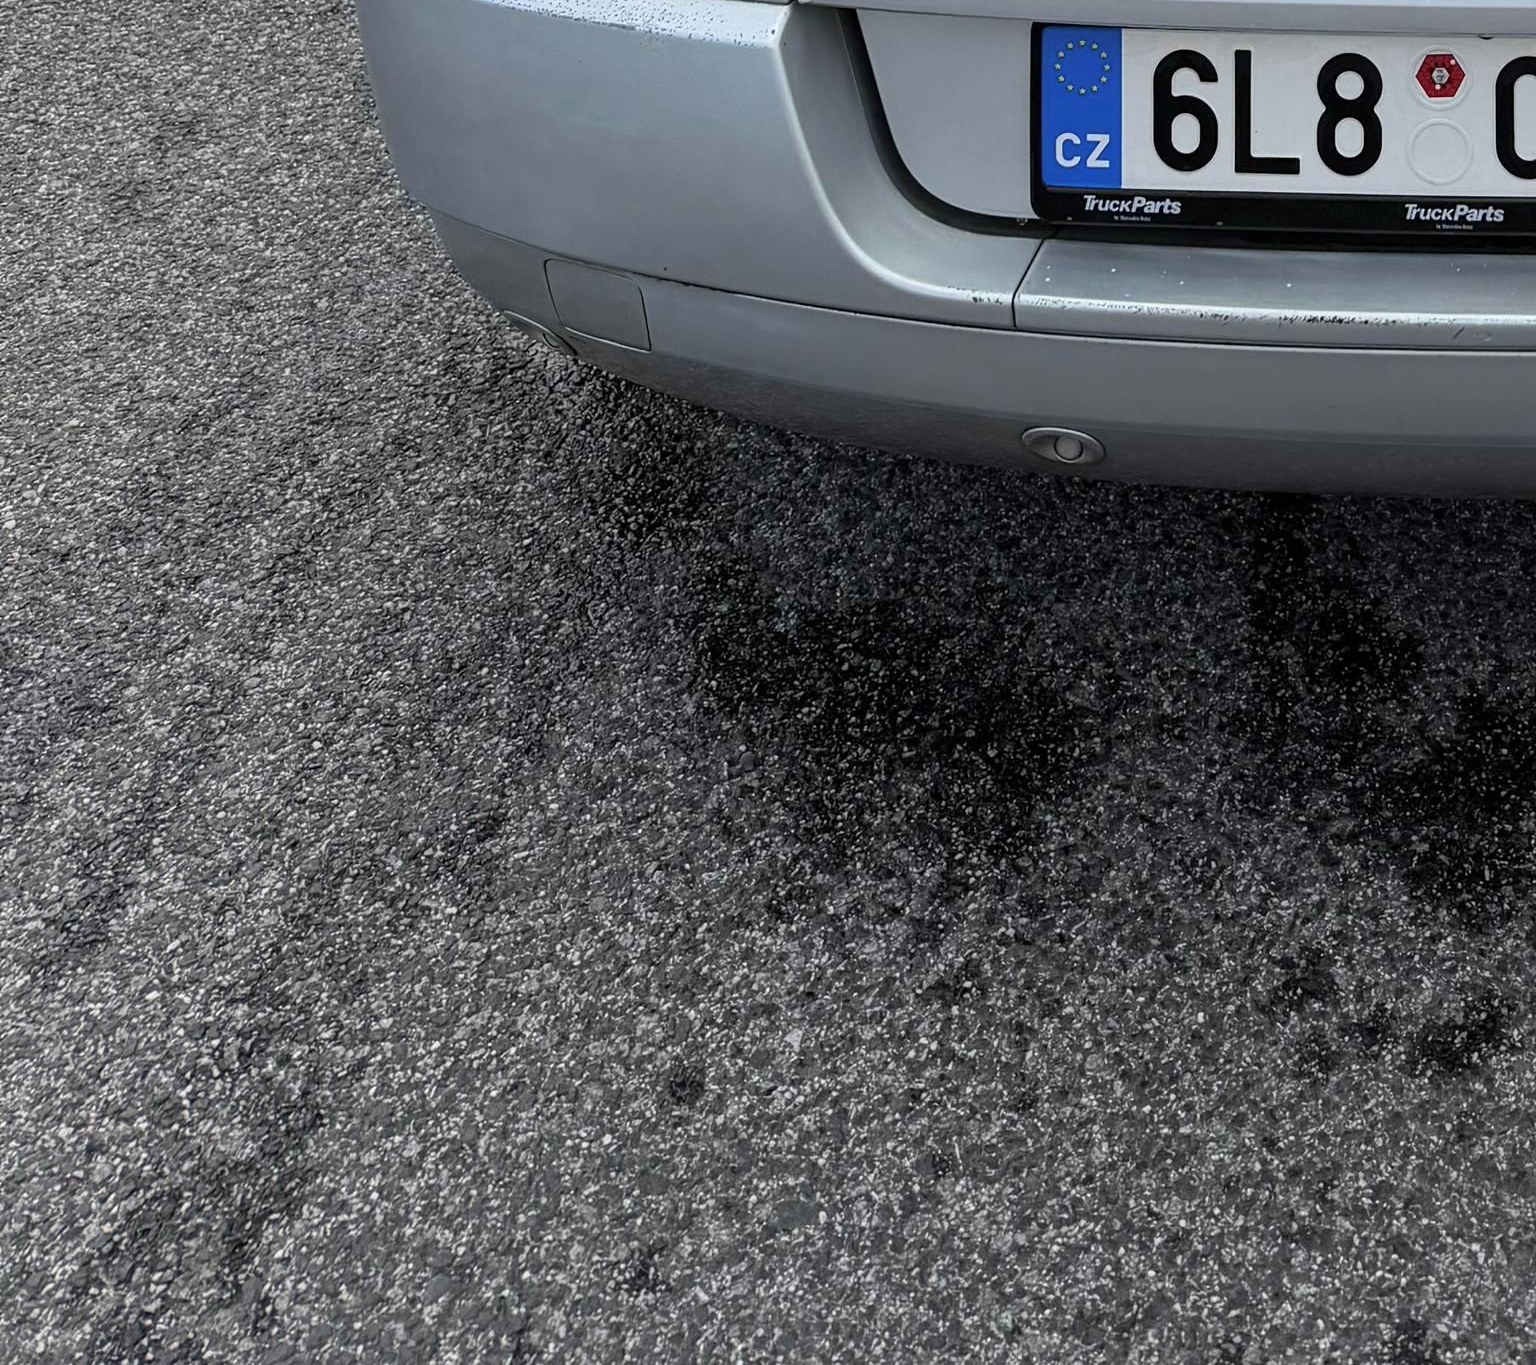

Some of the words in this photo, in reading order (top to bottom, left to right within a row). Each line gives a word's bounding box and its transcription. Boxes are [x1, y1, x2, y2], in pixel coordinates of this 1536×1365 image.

[1053, 131, 1112, 171] CZ
[1151, 48, 1383, 177] 6L8
[1083, 194, 1182, 215] TruckParts
[1404, 203, 1505, 222] TruckParts
